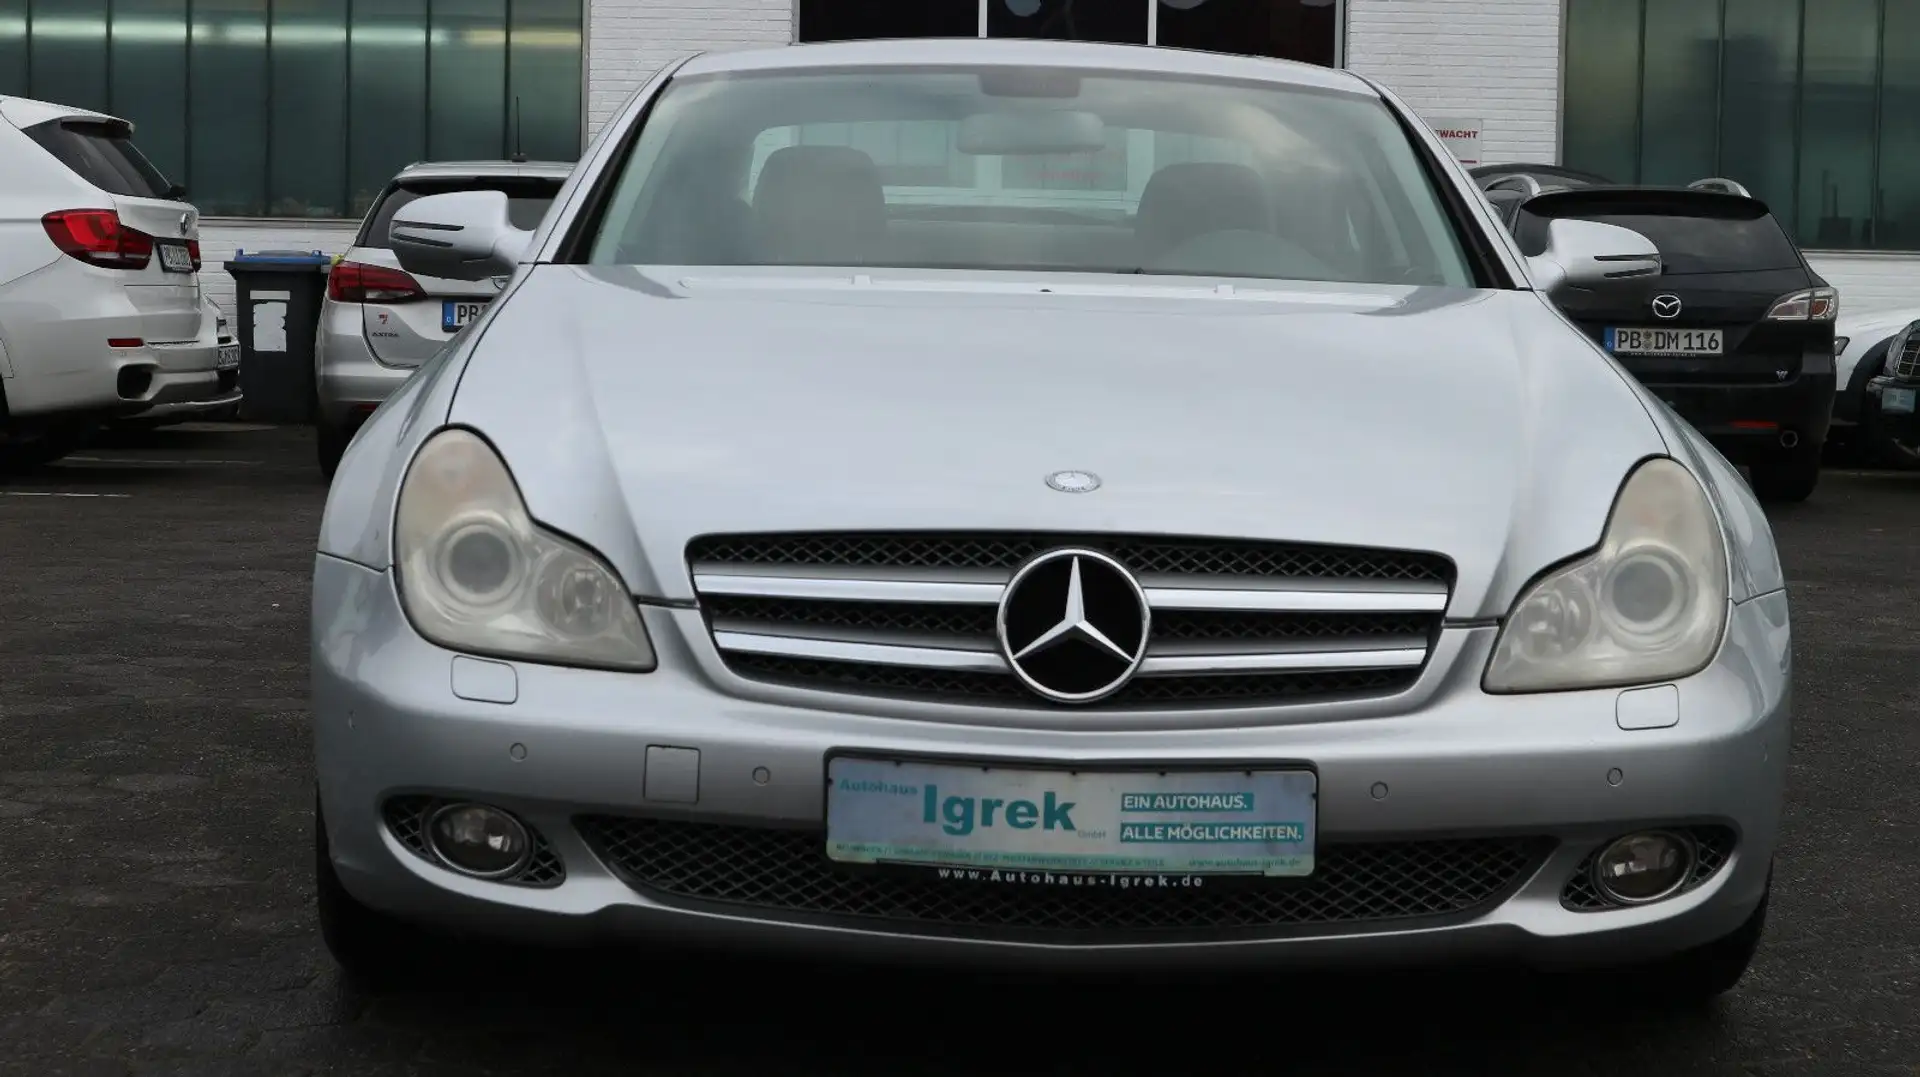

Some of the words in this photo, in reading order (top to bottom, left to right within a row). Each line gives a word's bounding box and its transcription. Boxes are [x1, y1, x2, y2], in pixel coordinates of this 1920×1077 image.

[1617, 331, 1642, 349] PB
[1653, 332, 1679, 350] DM
[1683, 332, 1719, 351] 116
[840, 777, 918, 796] Autohaus
[923, 784, 1076, 836] Igrek
[1123, 795, 1151, 809] EIN
[1154, 794, 1248, 809] AUTOHAUS.
[1122, 826, 1163, 840] ALLE
[1167, 822, 1303, 841] MÖGLICHKEITEN.
[938, 867, 1204, 889] www.Autohaus-Igrek.de
